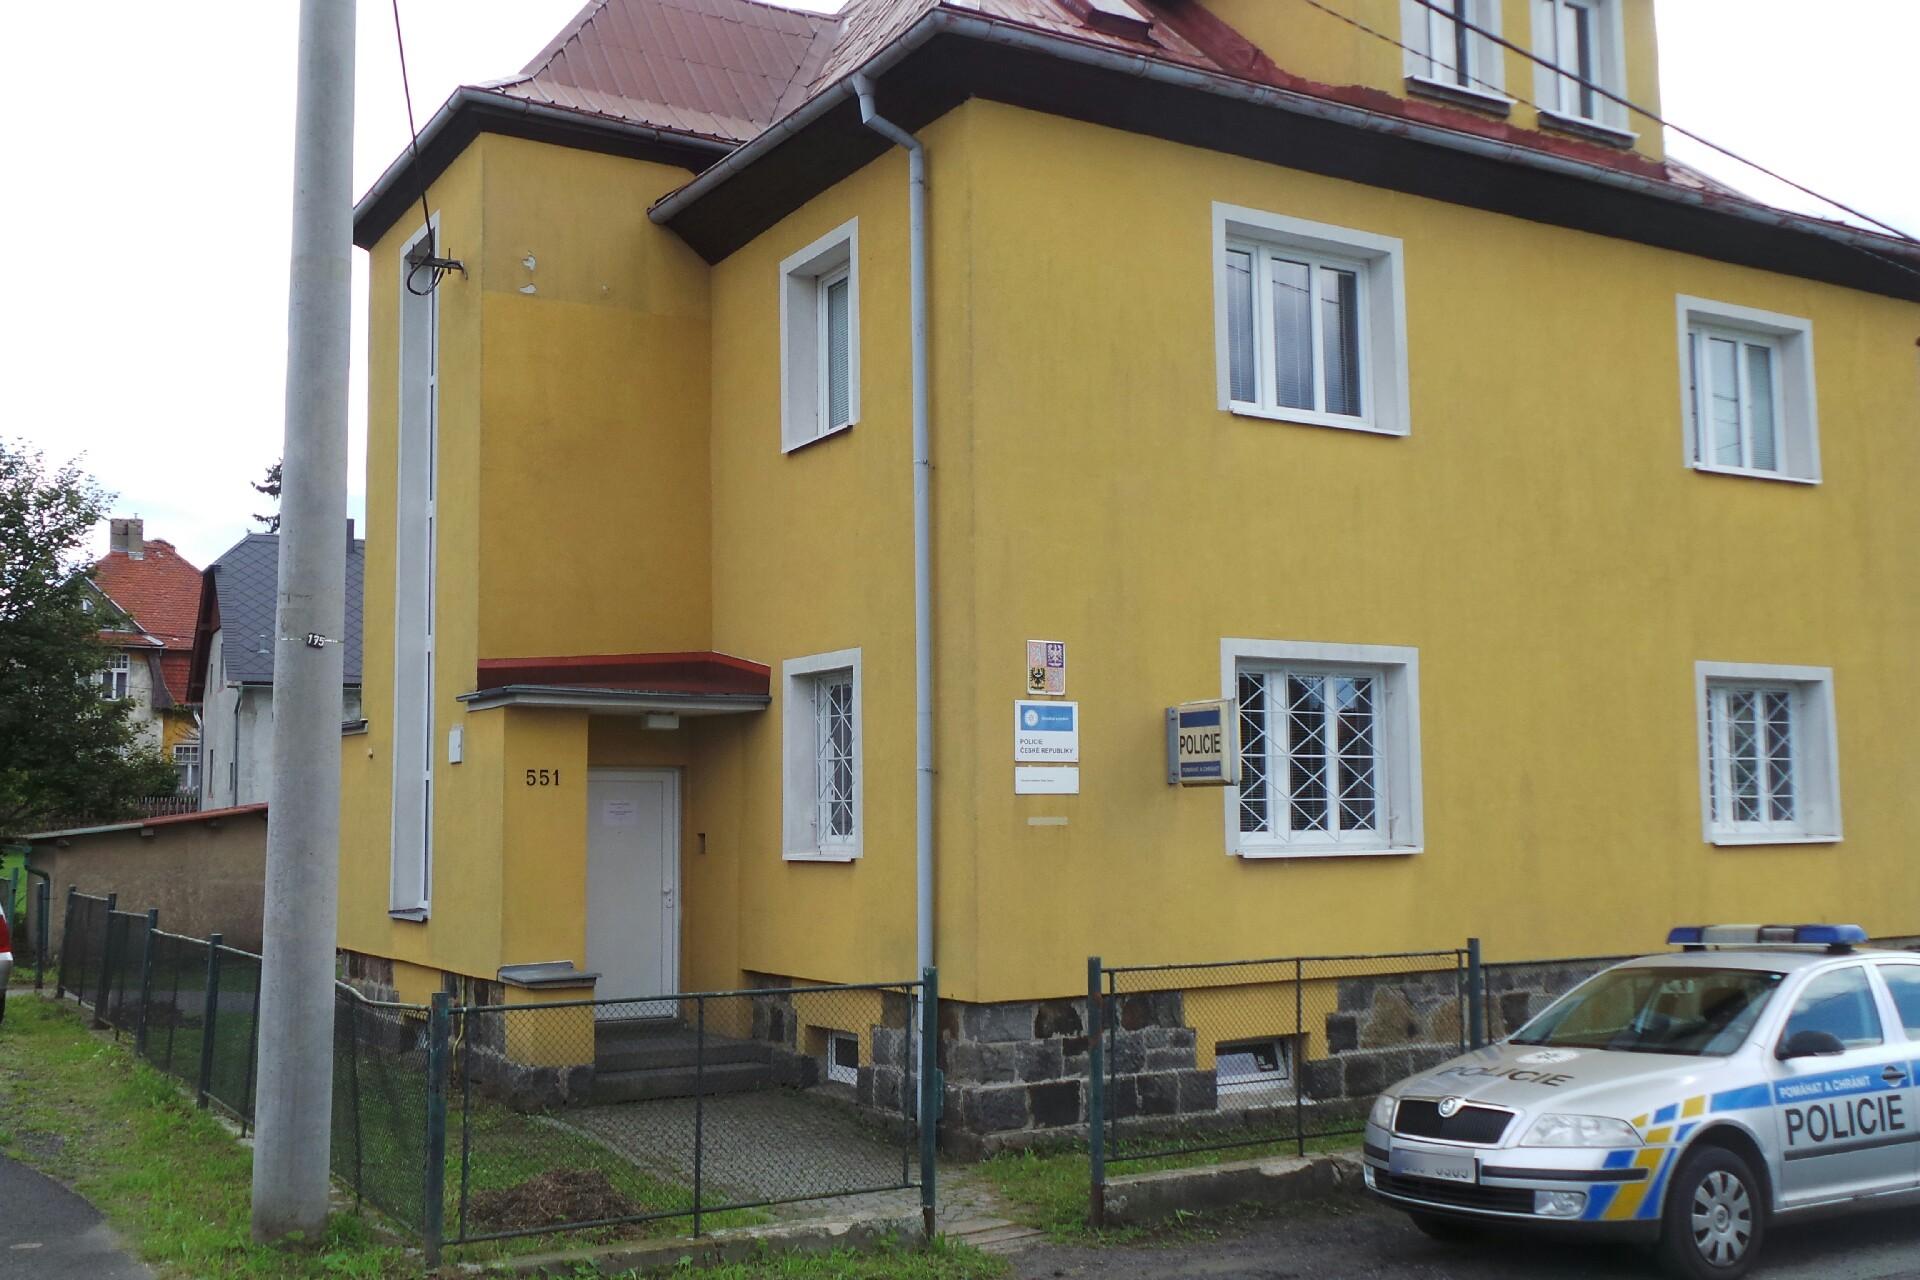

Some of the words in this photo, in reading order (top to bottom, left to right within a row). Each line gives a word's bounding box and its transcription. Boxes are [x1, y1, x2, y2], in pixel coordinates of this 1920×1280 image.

[307, 634, 326, 647] 175
[1019, 738, 1044, 746] POLICIE
[1179, 733, 1221, 755] POLICIE
[1041, 747, 1074, 755] REPUBLIKY
[526, 769, 560, 786] 551
[1436, 1066, 1575, 1088] POLICIE
[1824, 1080, 1832, 1092] A
[1784, 1095, 1905, 1146] POLICIE
